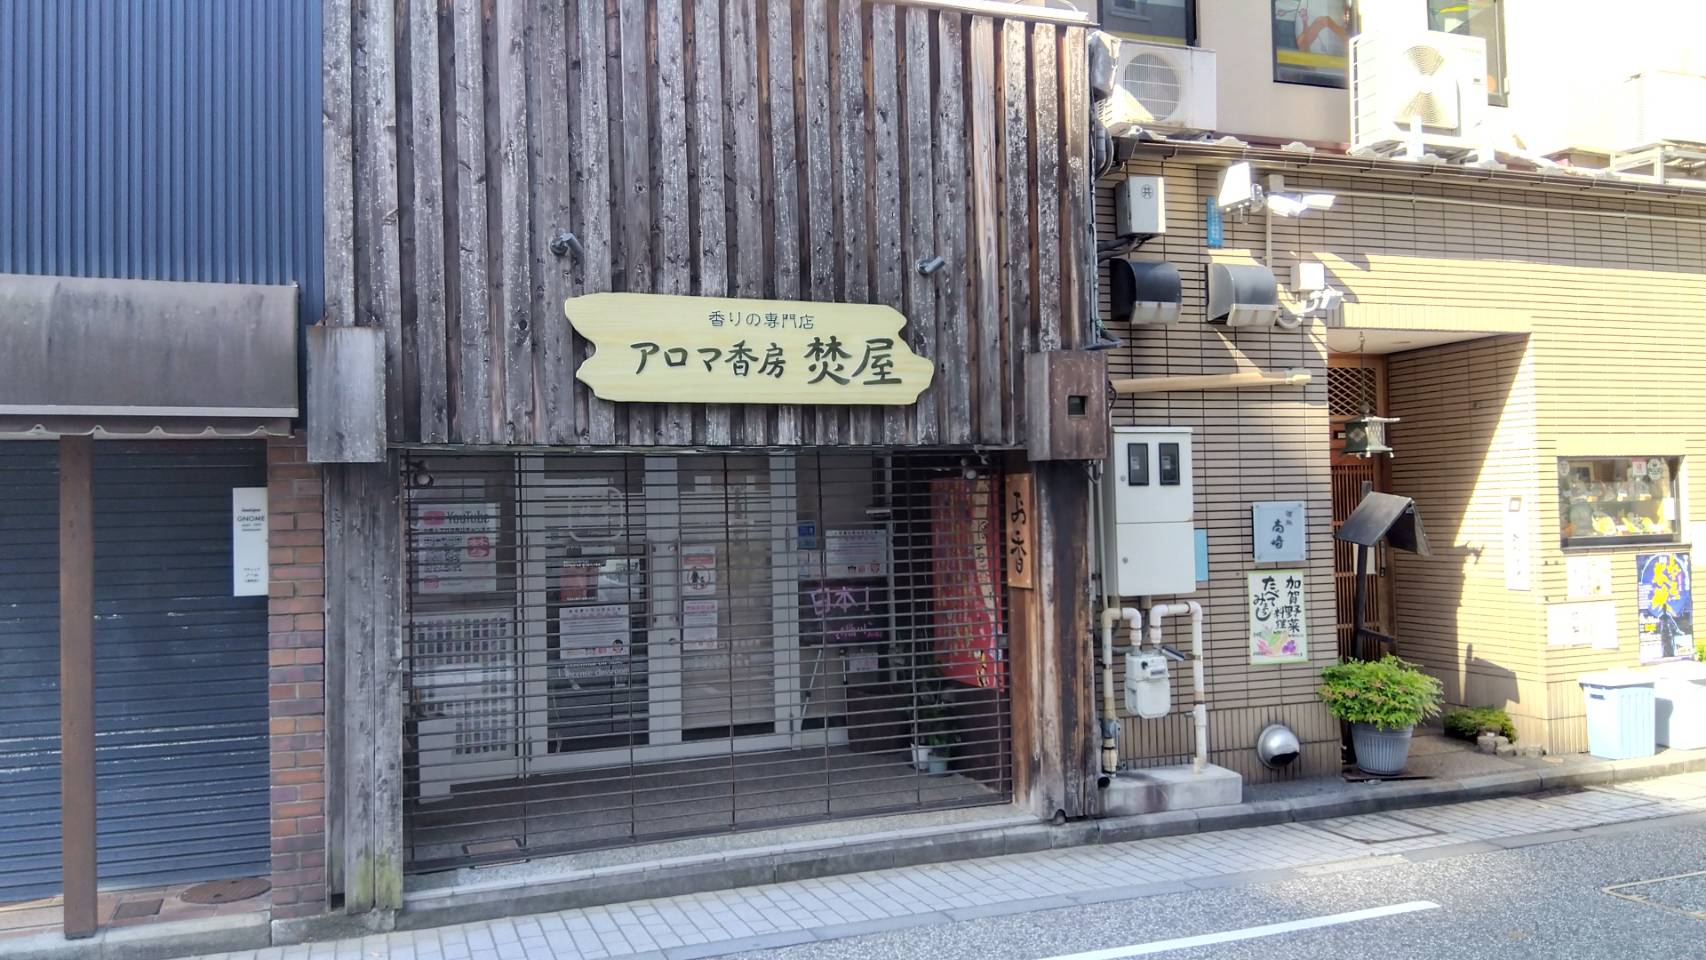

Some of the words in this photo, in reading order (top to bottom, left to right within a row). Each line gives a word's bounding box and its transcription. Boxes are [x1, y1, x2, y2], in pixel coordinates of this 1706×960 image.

[708, 310, 814, 330] 香りの専門店
[630, 339, 786, 378] アロマ香房
[803, 335, 902, 386] 焚屋
[447, 511, 490, 524] YouTube
[1262, 575, 1280, 607] たべて
[1286, 576, 1301, 632] 加賀野菜
[1274, 605, 1287, 630] 料理
